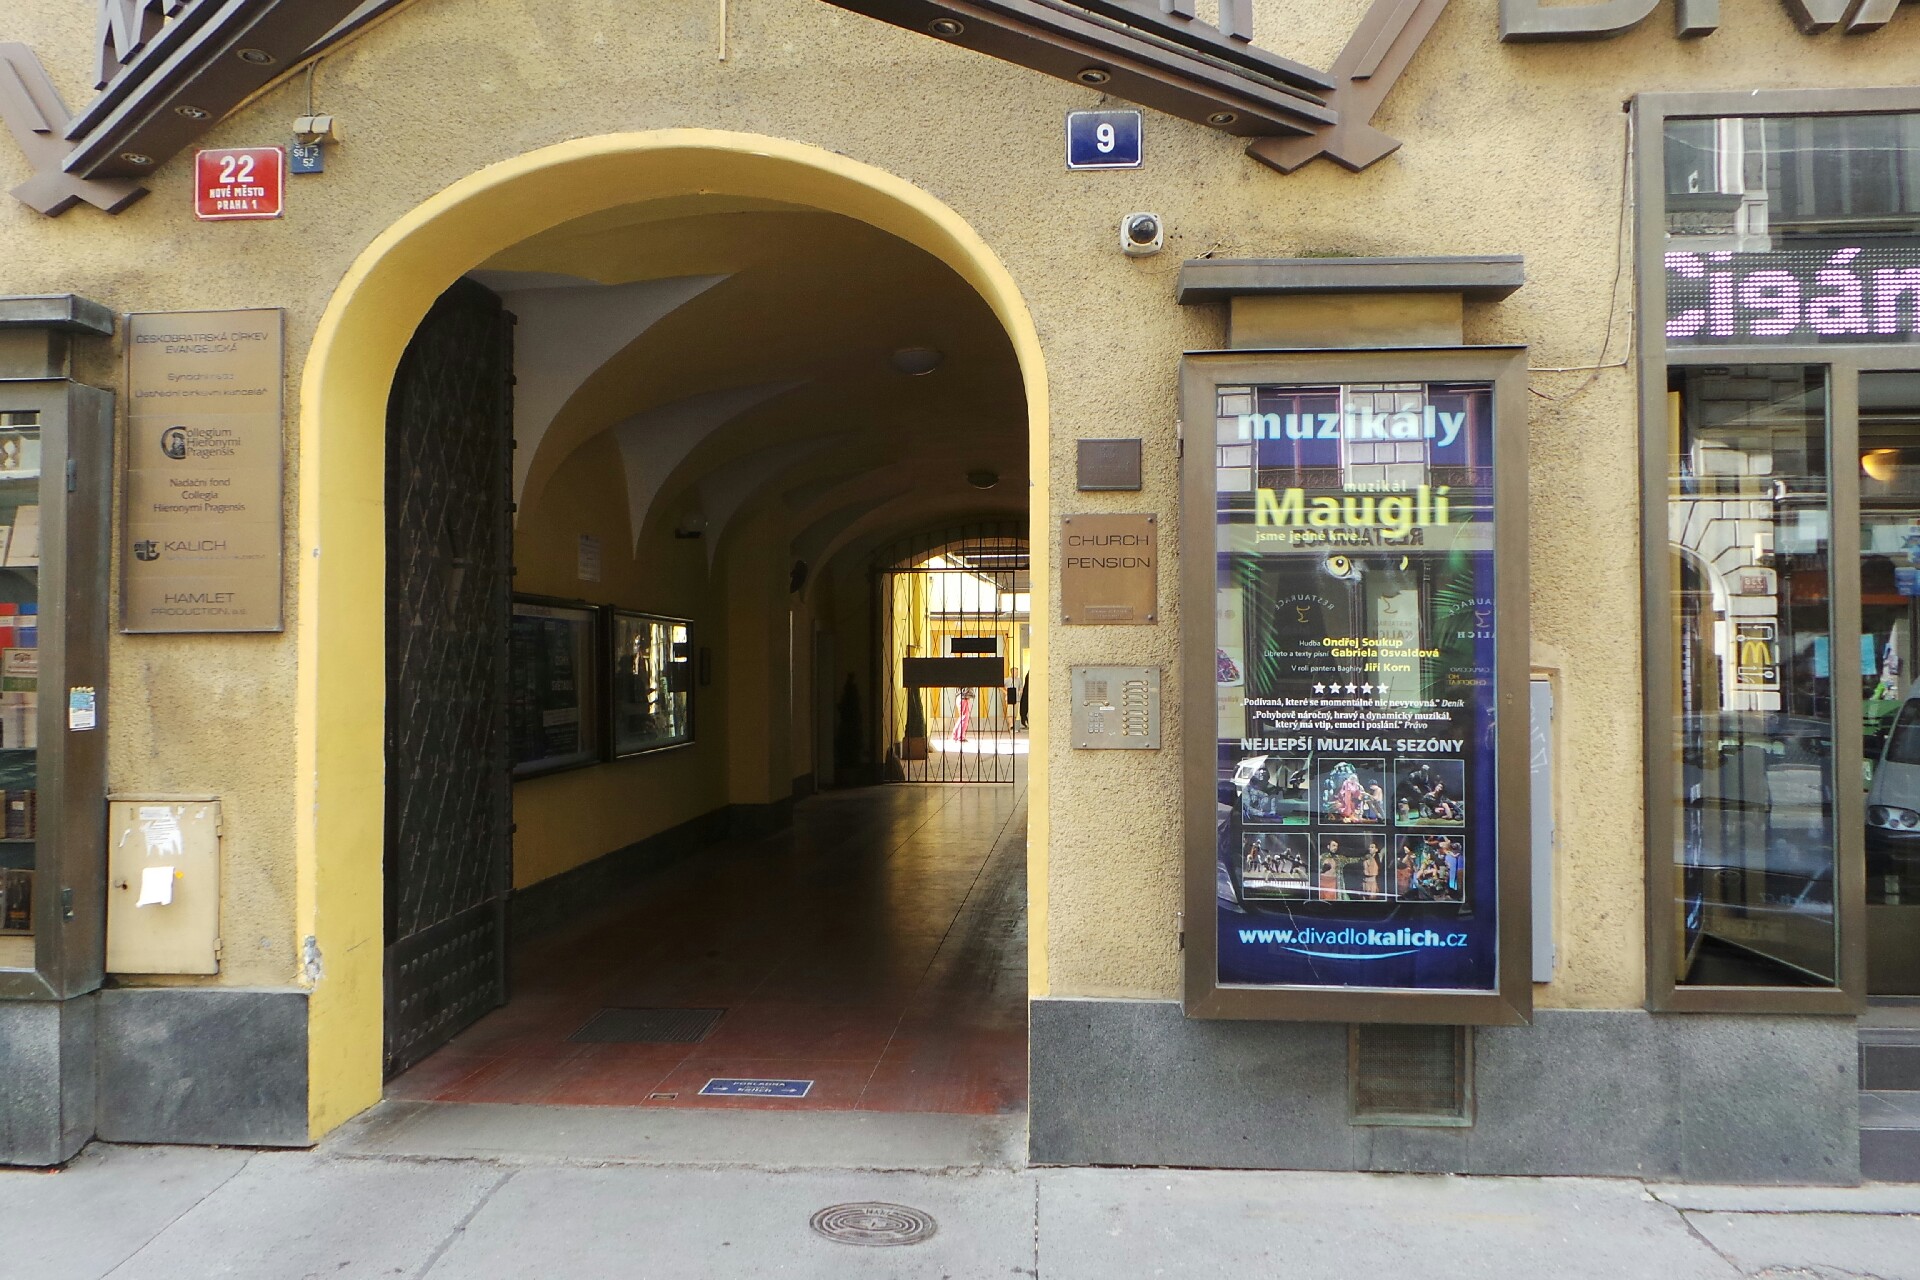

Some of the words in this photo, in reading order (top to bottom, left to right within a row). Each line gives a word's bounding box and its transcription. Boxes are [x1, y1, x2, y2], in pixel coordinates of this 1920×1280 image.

[1096, 123, 1115, 153] 9
[219, 155, 254, 183] 22
[209, 185, 231, 198] NOVÉ
[234, 185, 264, 197] MĚSTO
[217, 200, 248, 210] PRAHA
[252, 200, 258, 210] 1
[1237, 403, 1465, 447] muzikály
[187, 437, 241, 448] Hieronymi
[187, 448, 235, 459] Pragensis
[210, 478, 231, 487] fond
[1343, 480, 1406, 492] muzikál
[181, 490, 219, 501] Collegia
[153, 503, 202, 514] Hieronymi
[204, 503, 246, 513] Pragensis
[1255, 485, 1450, 538] Mauglí
[1068, 534, 1149, 546] CHURCH
[1255, 531, 1286, 543] jsme
[164, 540, 226, 551] KALICH
[1067, 557, 1150, 569] PENSION
[165, 592, 235, 604] HAMLET
[1322, 637, 1359, 648] Ondřej
[1362, 638, 1403, 649] Soukup
[1331, 648, 1378, 658] Gabriela
[1380, 648, 1439, 658] Osvaldová
[1310, 665, 1336, 673] pantera
[1364, 662, 1380, 672] Jiří
[1383, 663, 1411, 672] Korn
[1285, 698, 1309, 706] které
[1320, 698, 1373, 706] momentálně
[1375, 698, 1387, 706] nic
[1441, 699, 1465, 707] Deník
[1297, 710, 1333, 720] náročný,
[1334, 710, 1358, 720] hravý
[1366, 711, 1413, 721] dynamický
[1275, 720, 1298, 730] který
[1315, 721, 1334, 730] vtip,
[1334, 721, 1361, 729] emoci
[1240, 736, 1313, 751] NEJLEPŠÍ
[1317, 736, 1392, 752] MUZIKÁL
[1396, 738, 1464, 753] SEZÓNY
[1238, 927, 1468, 947] www.divadlokalich.cz
